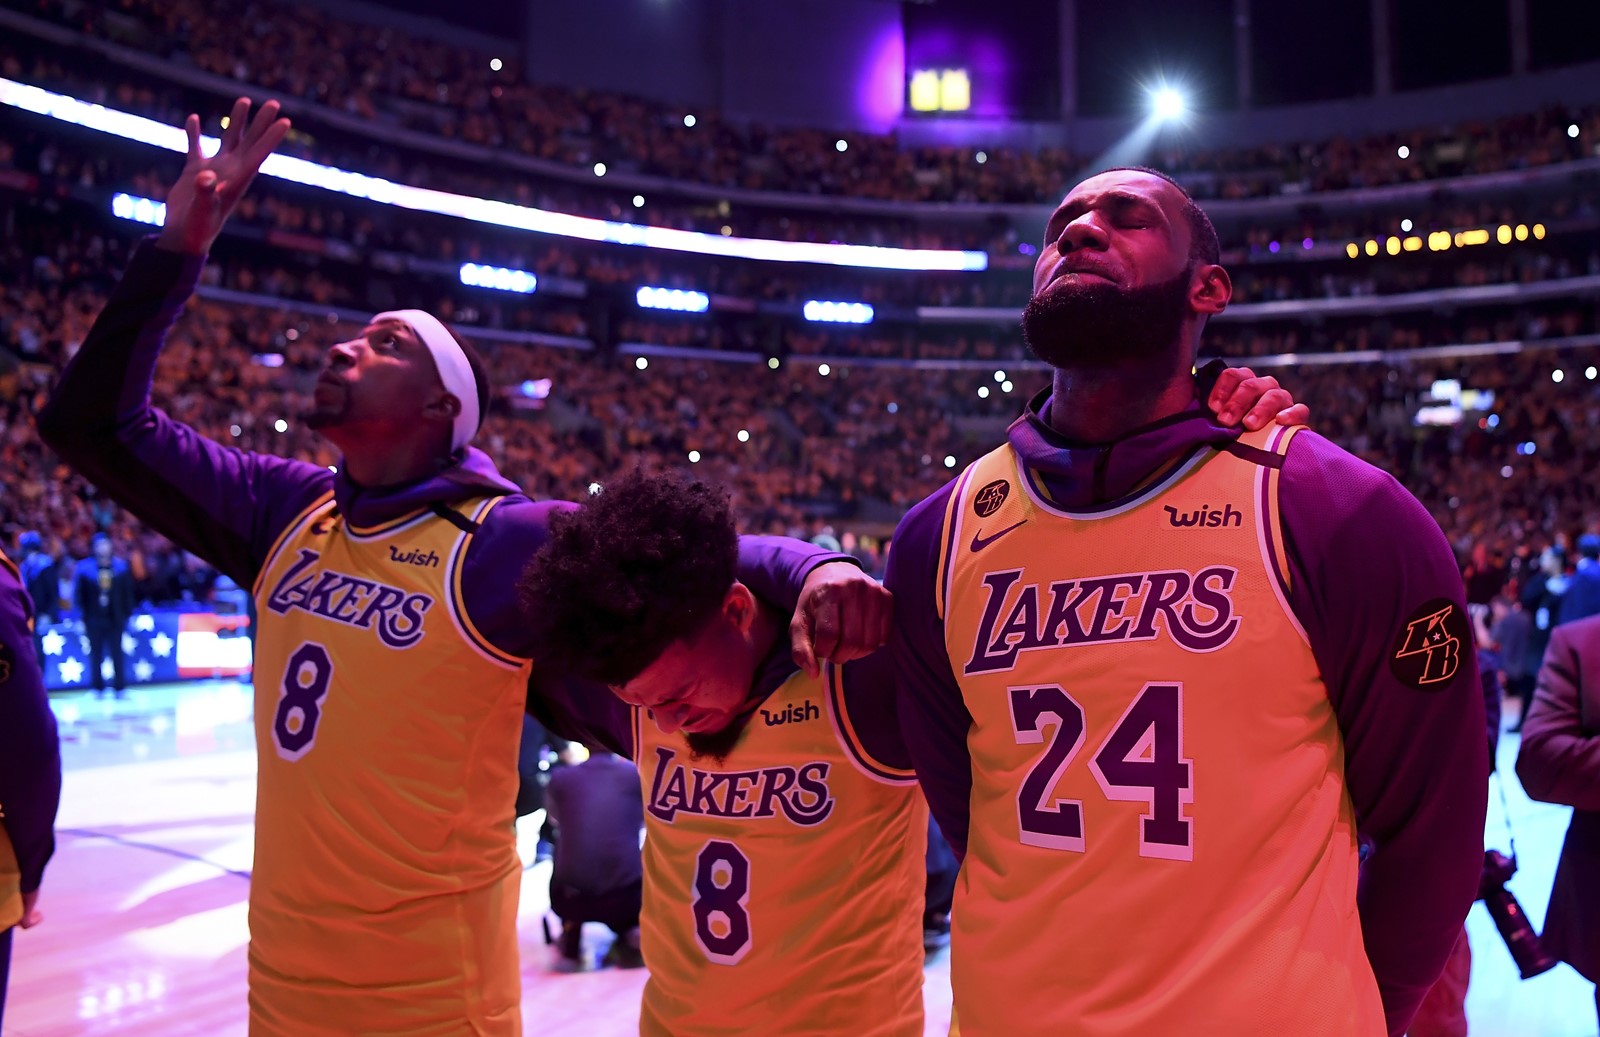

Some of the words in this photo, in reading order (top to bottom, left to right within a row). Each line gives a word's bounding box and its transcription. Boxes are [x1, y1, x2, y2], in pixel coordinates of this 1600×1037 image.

[390, 545, 439, 568] wish
[1164, 504, 1243, 528] wish
[267, 547, 434, 649] LAKERS
[964, 566, 1242, 676] LAKERS
[272, 641, 335, 762] 8
[761, 701, 820, 727] wish
[647, 747, 836, 826] LAKERS
[1007, 682, 1194, 862] 24
[692, 839, 753, 966] 8
